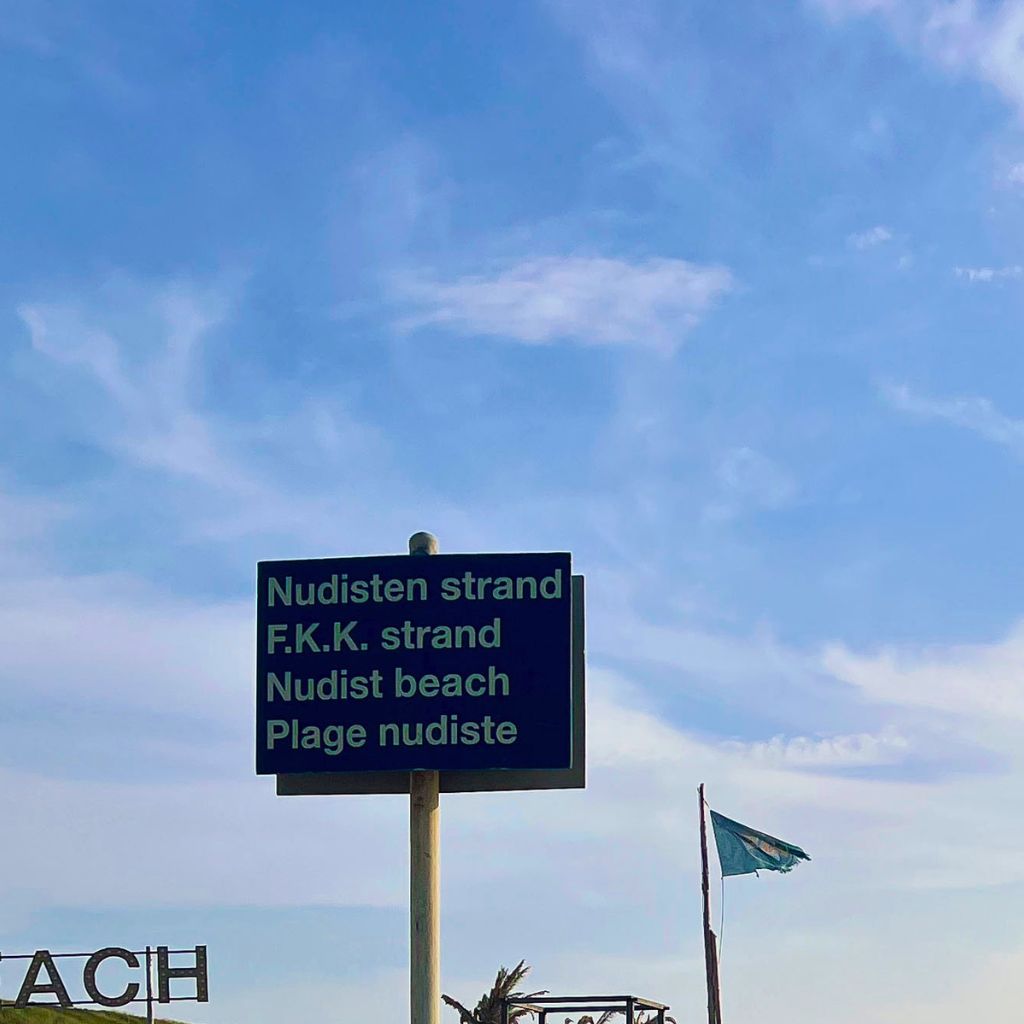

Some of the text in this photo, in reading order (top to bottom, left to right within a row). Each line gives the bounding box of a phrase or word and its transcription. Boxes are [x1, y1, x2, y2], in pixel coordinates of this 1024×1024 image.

[268, 569, 561, 606] Nudisten strand
[268, 618, 500, 654] F.K.K. strand
[268, 666, 509, 701] Nudist beach
[267, 715, 517, 755] Plage nudiste
[0, 945, 208, 1009] ACH
